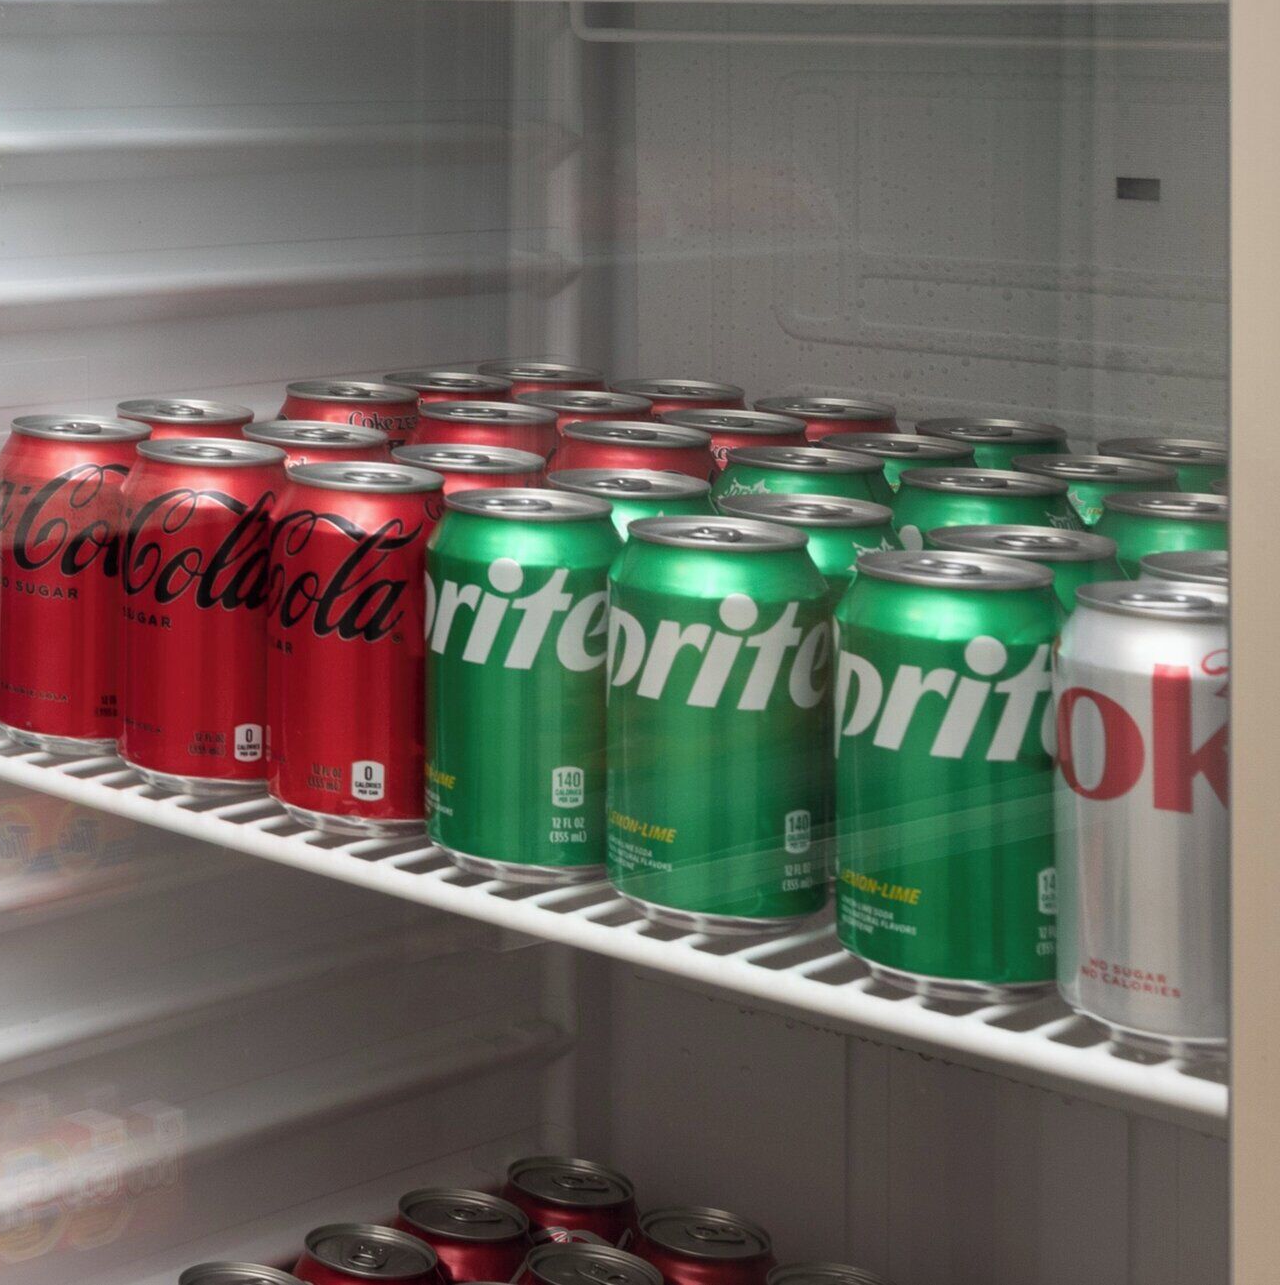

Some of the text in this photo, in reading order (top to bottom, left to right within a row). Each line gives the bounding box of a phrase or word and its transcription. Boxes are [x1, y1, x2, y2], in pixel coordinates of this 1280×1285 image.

[119, 488, 273, 612] Cola
[15, 579, 80, 600] SUGAR
[424, 557, 608, 673] rite
[607, 592, 830, 712] prite
[835, 635, 1054, 763] prit
[354, 781, 382, 790] CALORIES
[556, 770, 582, 789] 140
[554, 788, 583, 797] CALORIES
[552, 817, 585, 830] 12 FL OZ
[550, 829, 570, 844] (355
[1080, 966, 1182, 998] NO CALORIES
[1090, 957, 1167, 984] NO SUGAR
